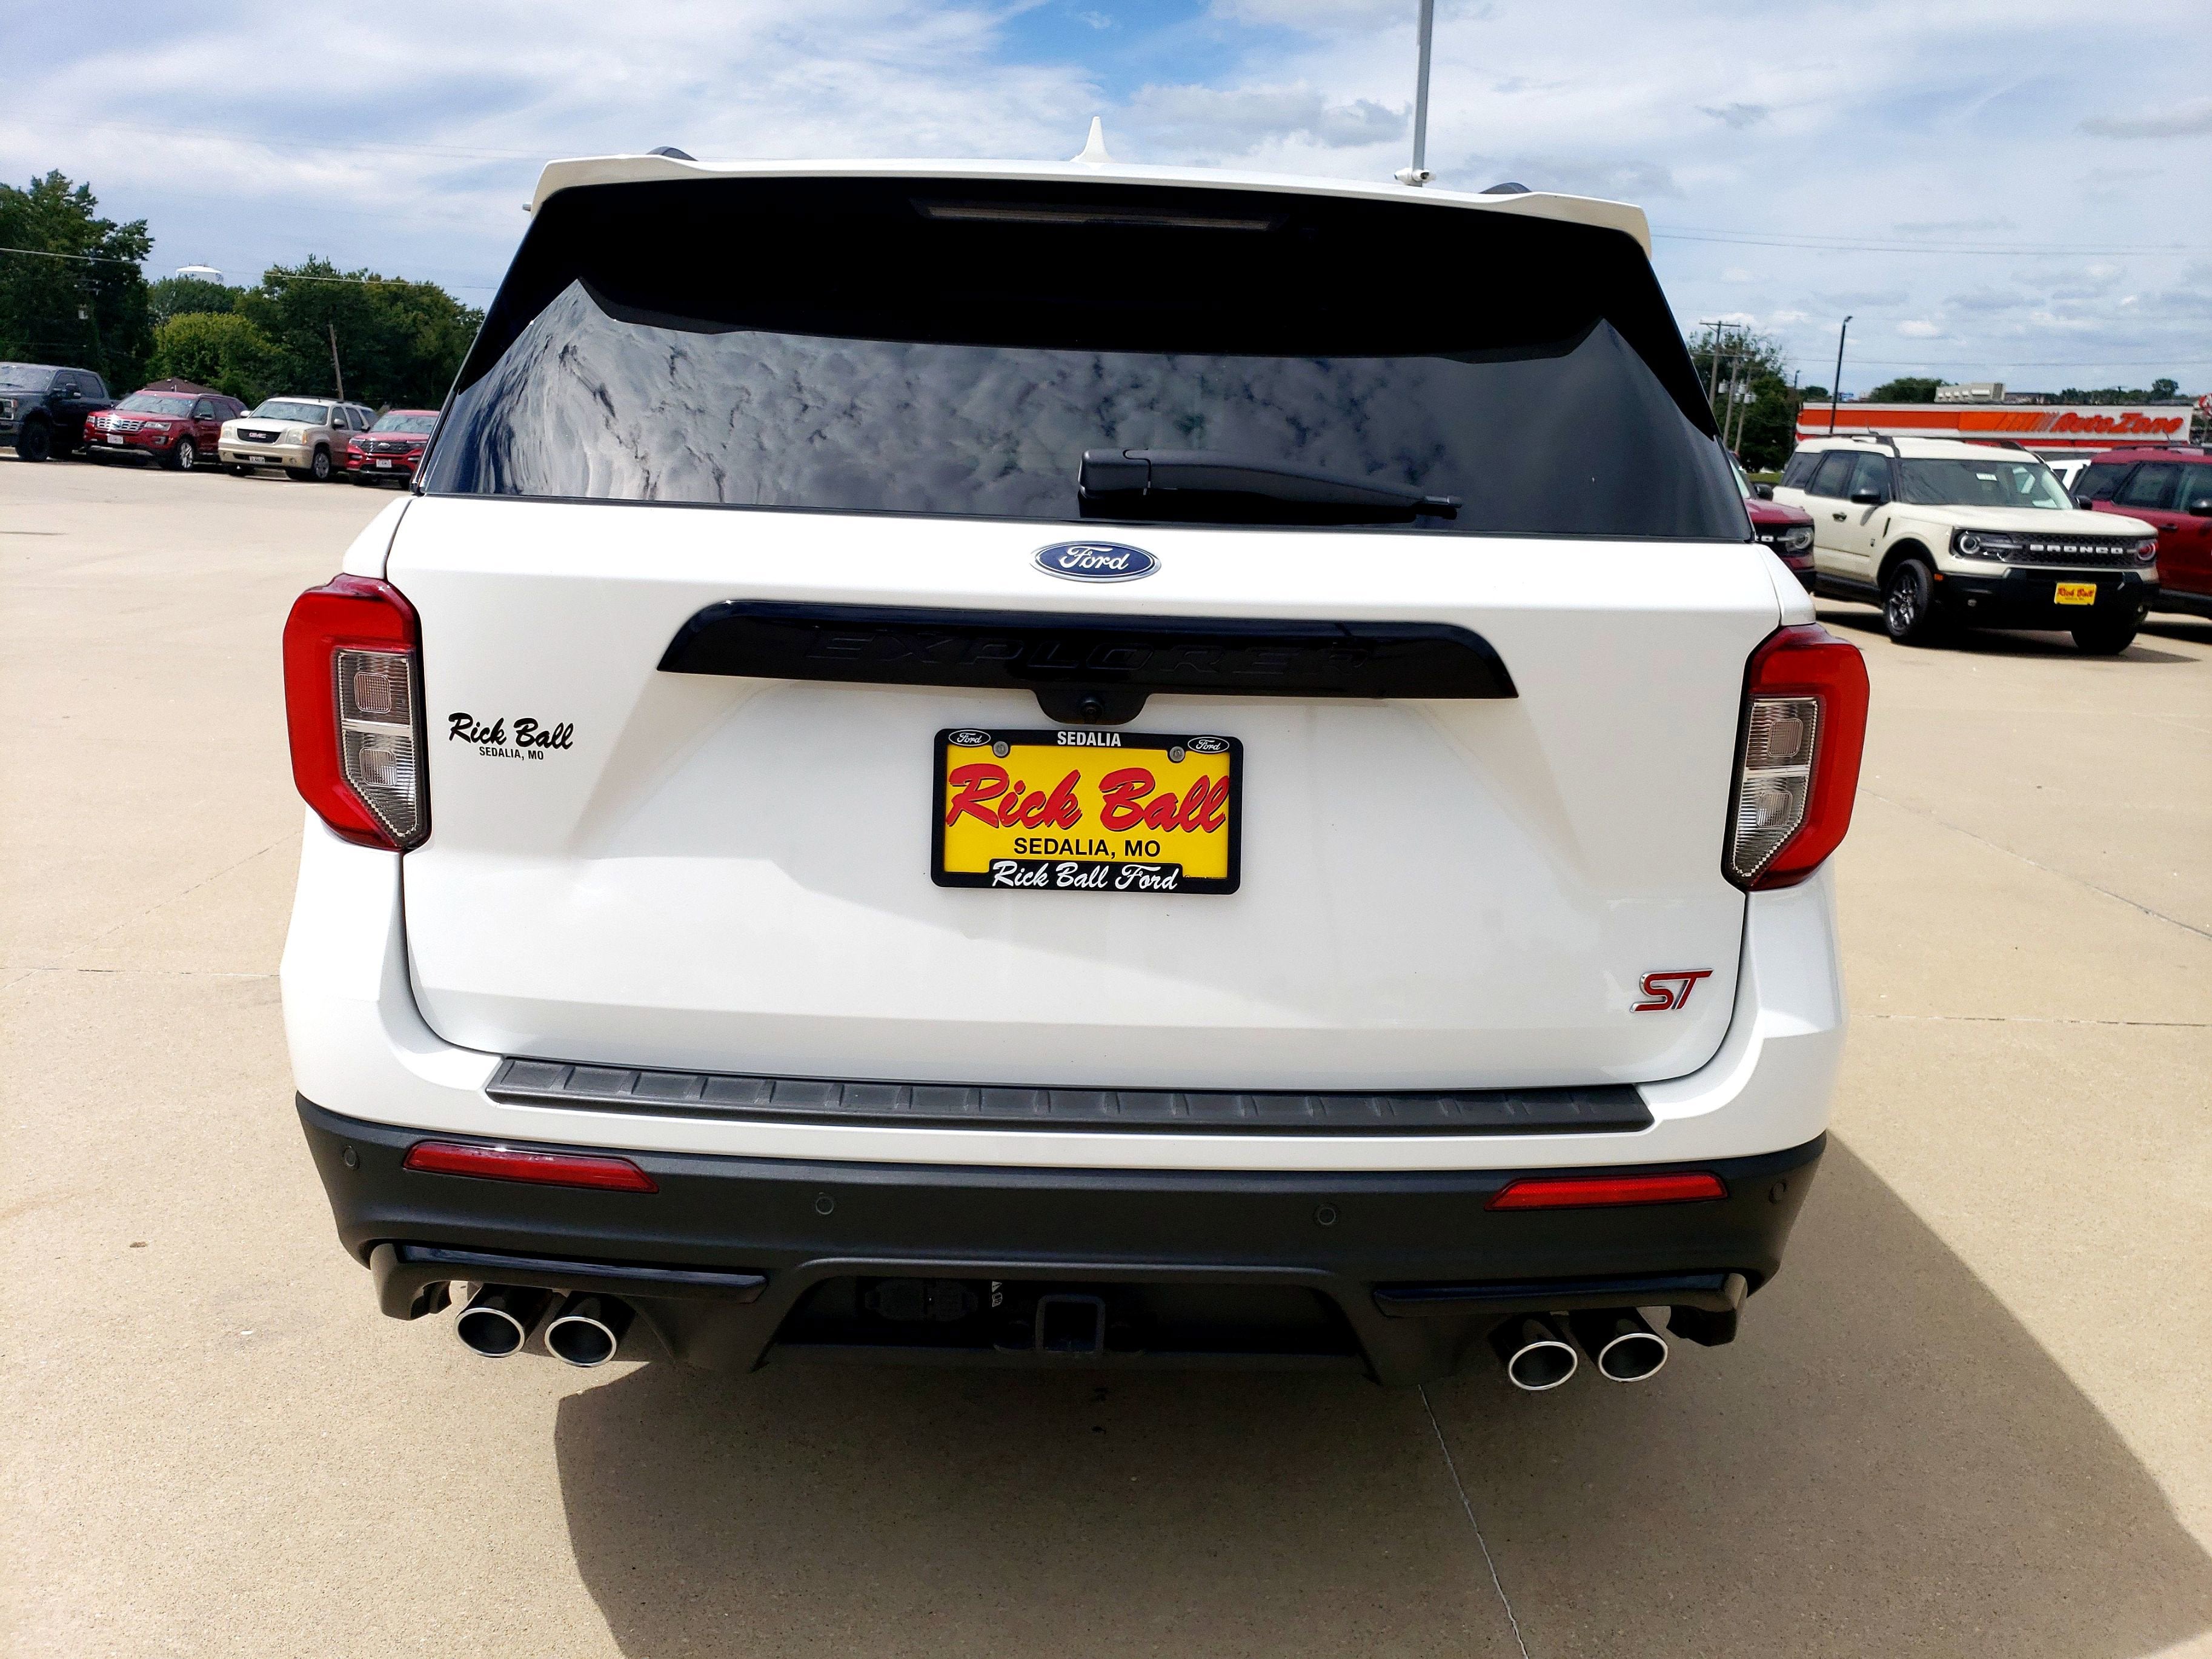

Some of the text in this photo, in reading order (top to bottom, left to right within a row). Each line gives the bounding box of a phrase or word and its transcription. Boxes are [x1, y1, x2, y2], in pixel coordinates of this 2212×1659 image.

[2050, 411, 2184, 434] AutoZone
[1059, 546, 1131, 570] Ford
[2030, 544, 2123, 554] BRONCO
[805, 631, 1369, 676] EXPLORER
[448, 712, 574, 750] Rick Ball
[956, 732, 983, 745] Ford
[1057, 731, 1122, 747] SEDALIA
[479, 746, 545, 761] SEDALIA, MO
[1195, 739, 1221, 751] Ford
[945, 763, 1231, 833] Rick Ball
[1014, 837, 1161, 860] SEDALIA, MO
[992, 860, 1179, 891] Rick Ball Ford
[1629, 968, 1715, 1013] ST
